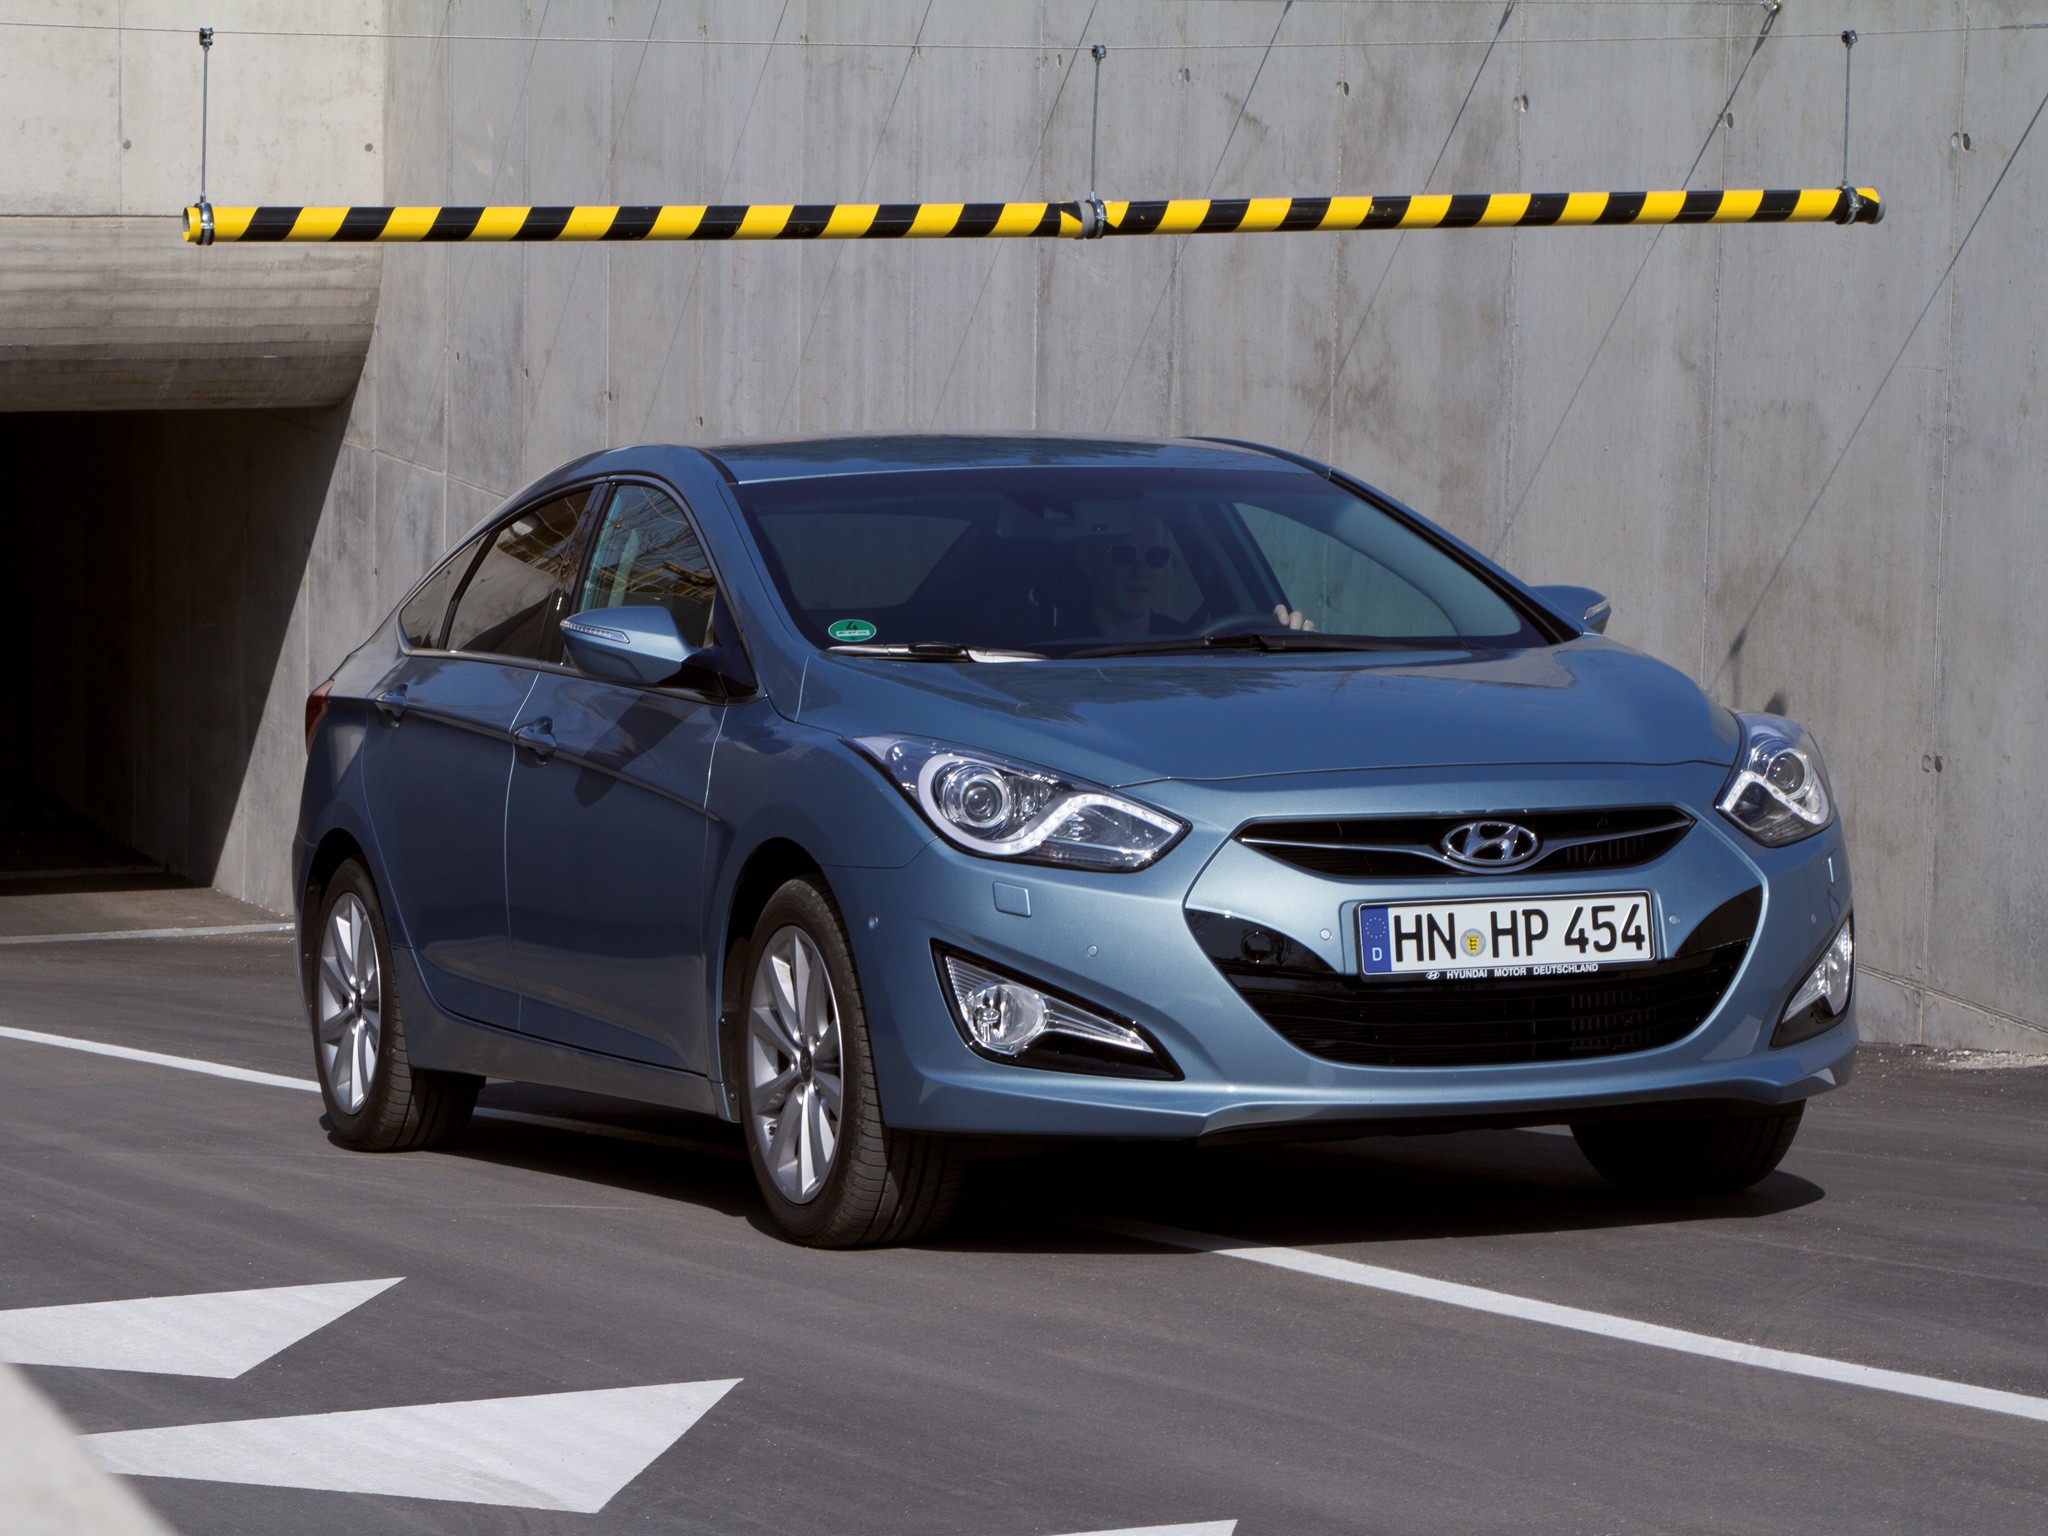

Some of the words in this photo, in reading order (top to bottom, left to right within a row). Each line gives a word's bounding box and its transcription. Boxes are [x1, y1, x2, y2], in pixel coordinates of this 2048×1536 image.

[1393, 912, 1457, 962] HN
[1490, 908, 1549, 958] HP
[1564, 903, 1645, 954] 454
[1371, 947, 1383, 962] D
[1446, 968, 1488, 980] HYUNDAI
[1494, 966, 1527, 977] MOTOR
[1533, 963, 1599, 976] DEUTSCHLAND
